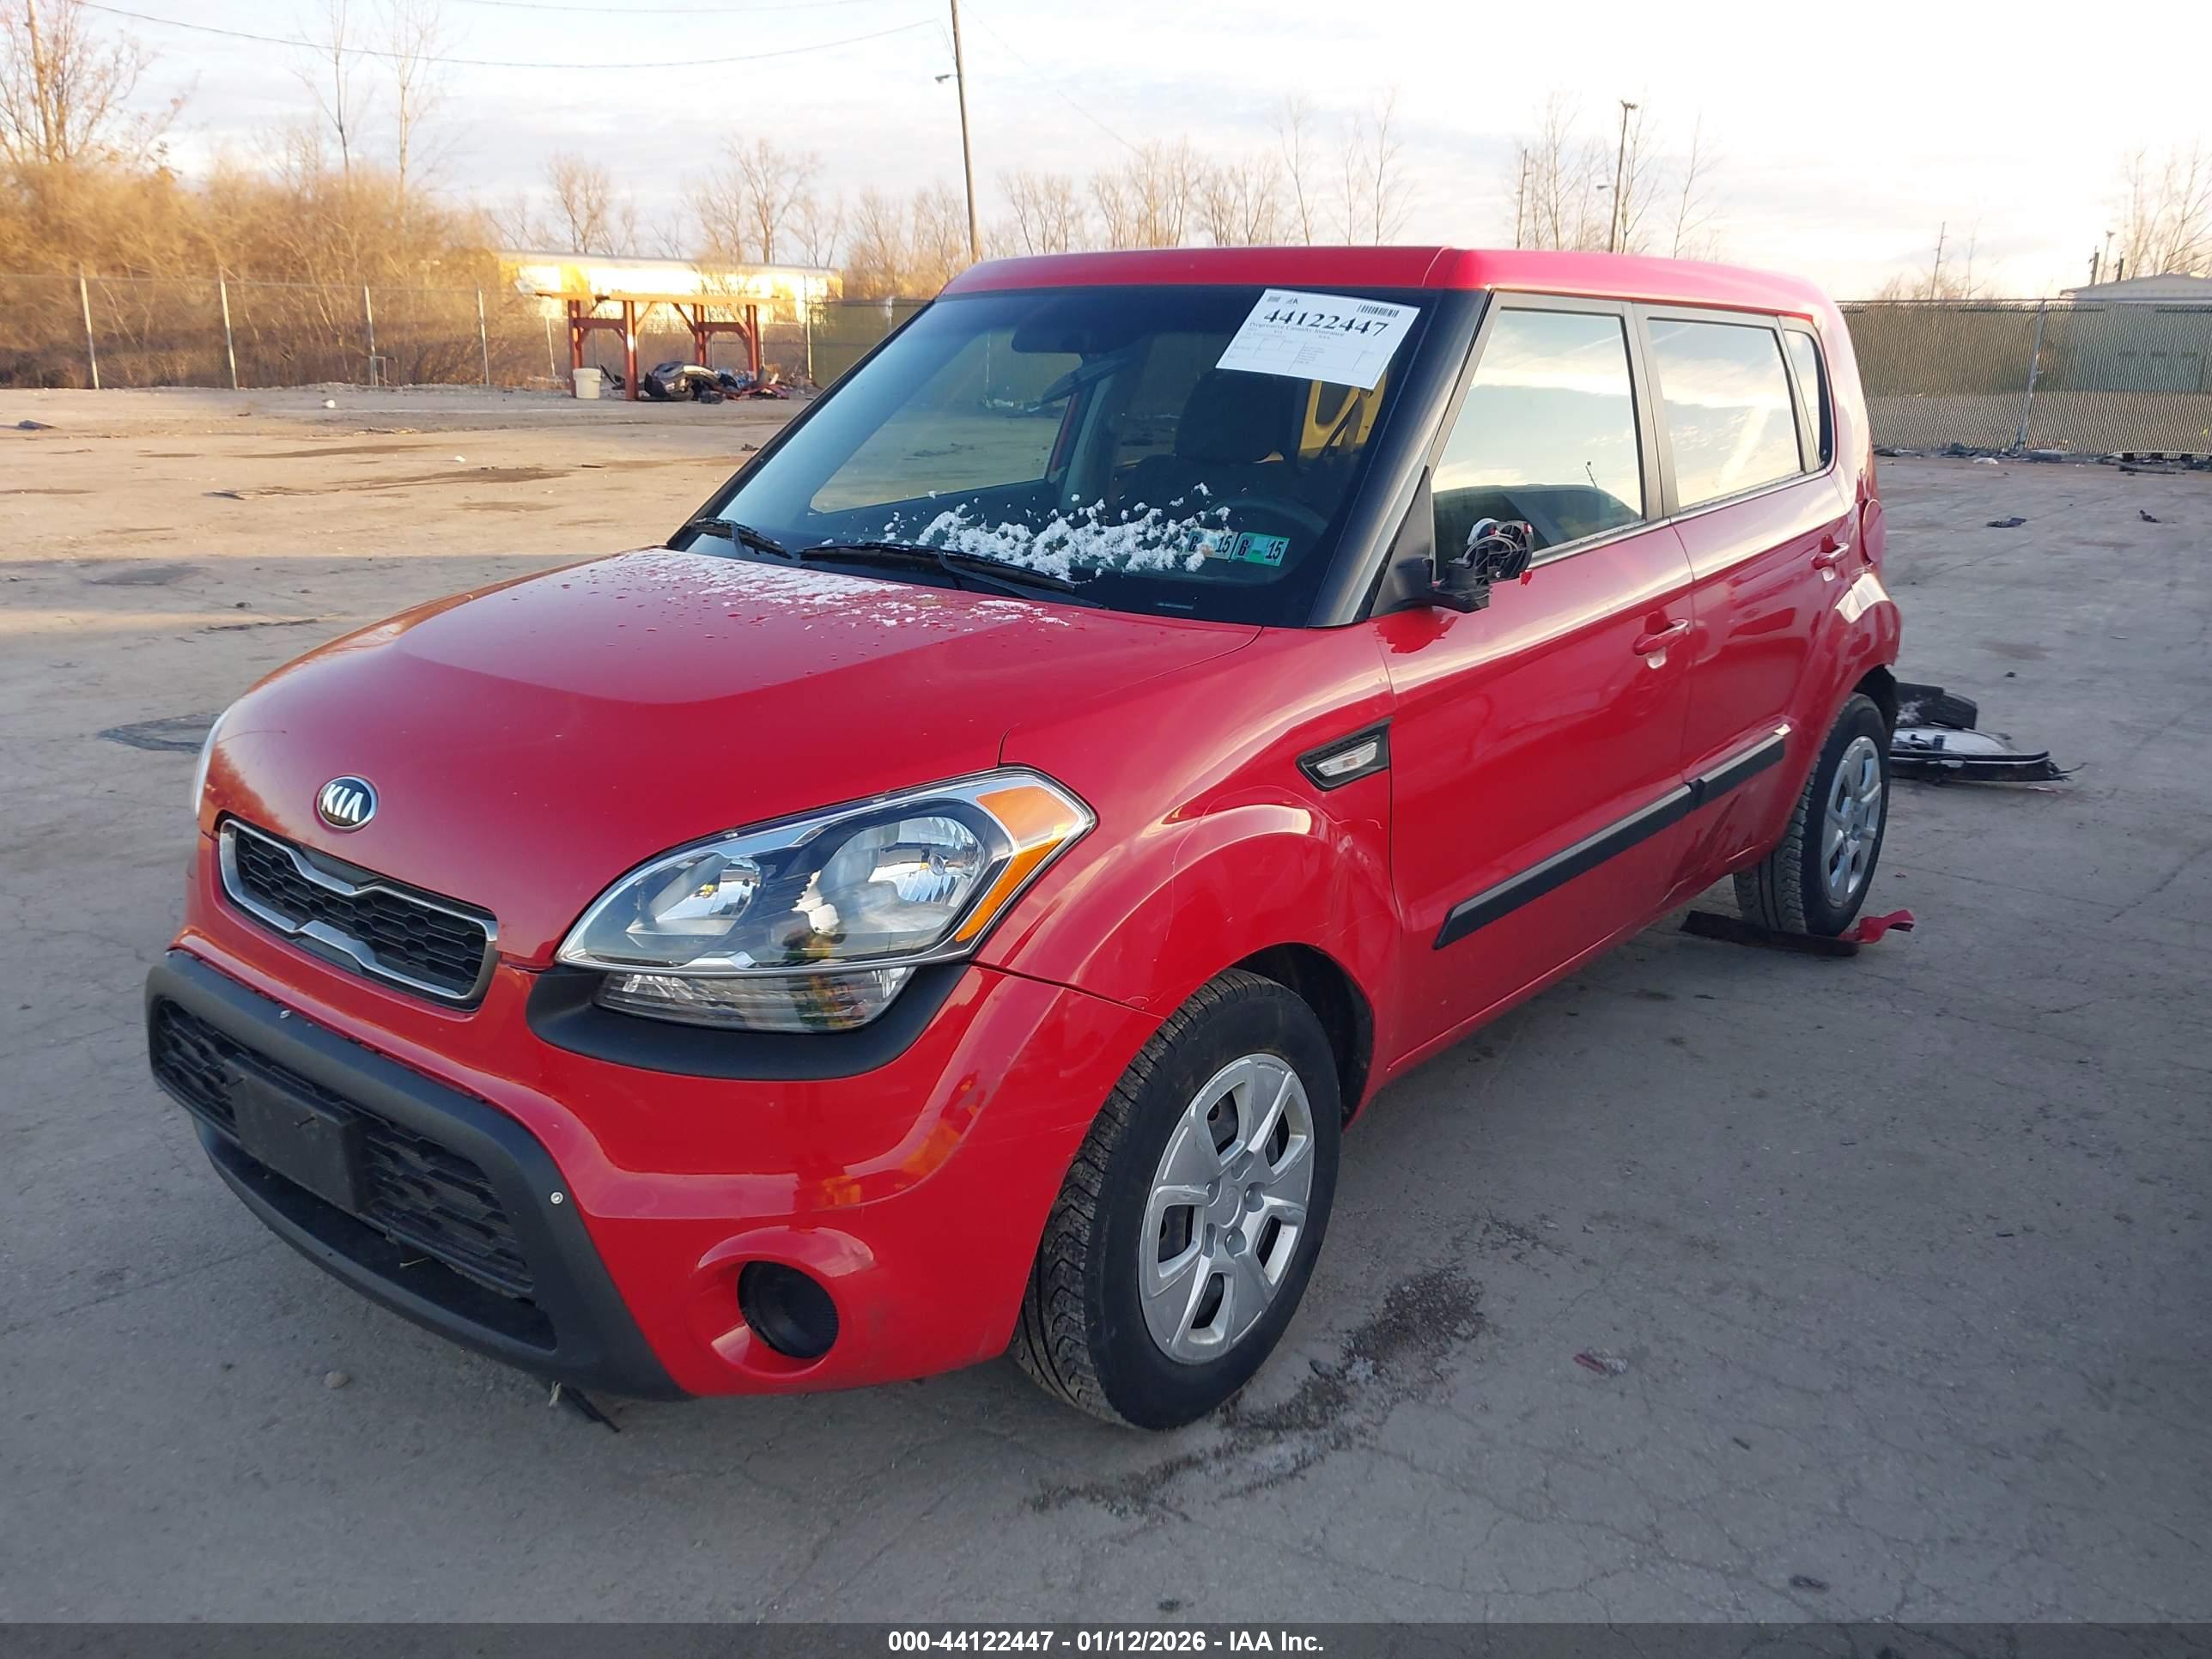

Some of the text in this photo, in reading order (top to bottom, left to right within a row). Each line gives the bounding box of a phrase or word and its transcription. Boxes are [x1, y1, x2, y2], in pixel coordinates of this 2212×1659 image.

[1263, 308, 1389, 337] 44122447
[1215, 535, 1233, 553] 15
[1265, 540, 1285, 559] 15
[320, 783, 364, 823] KIA
